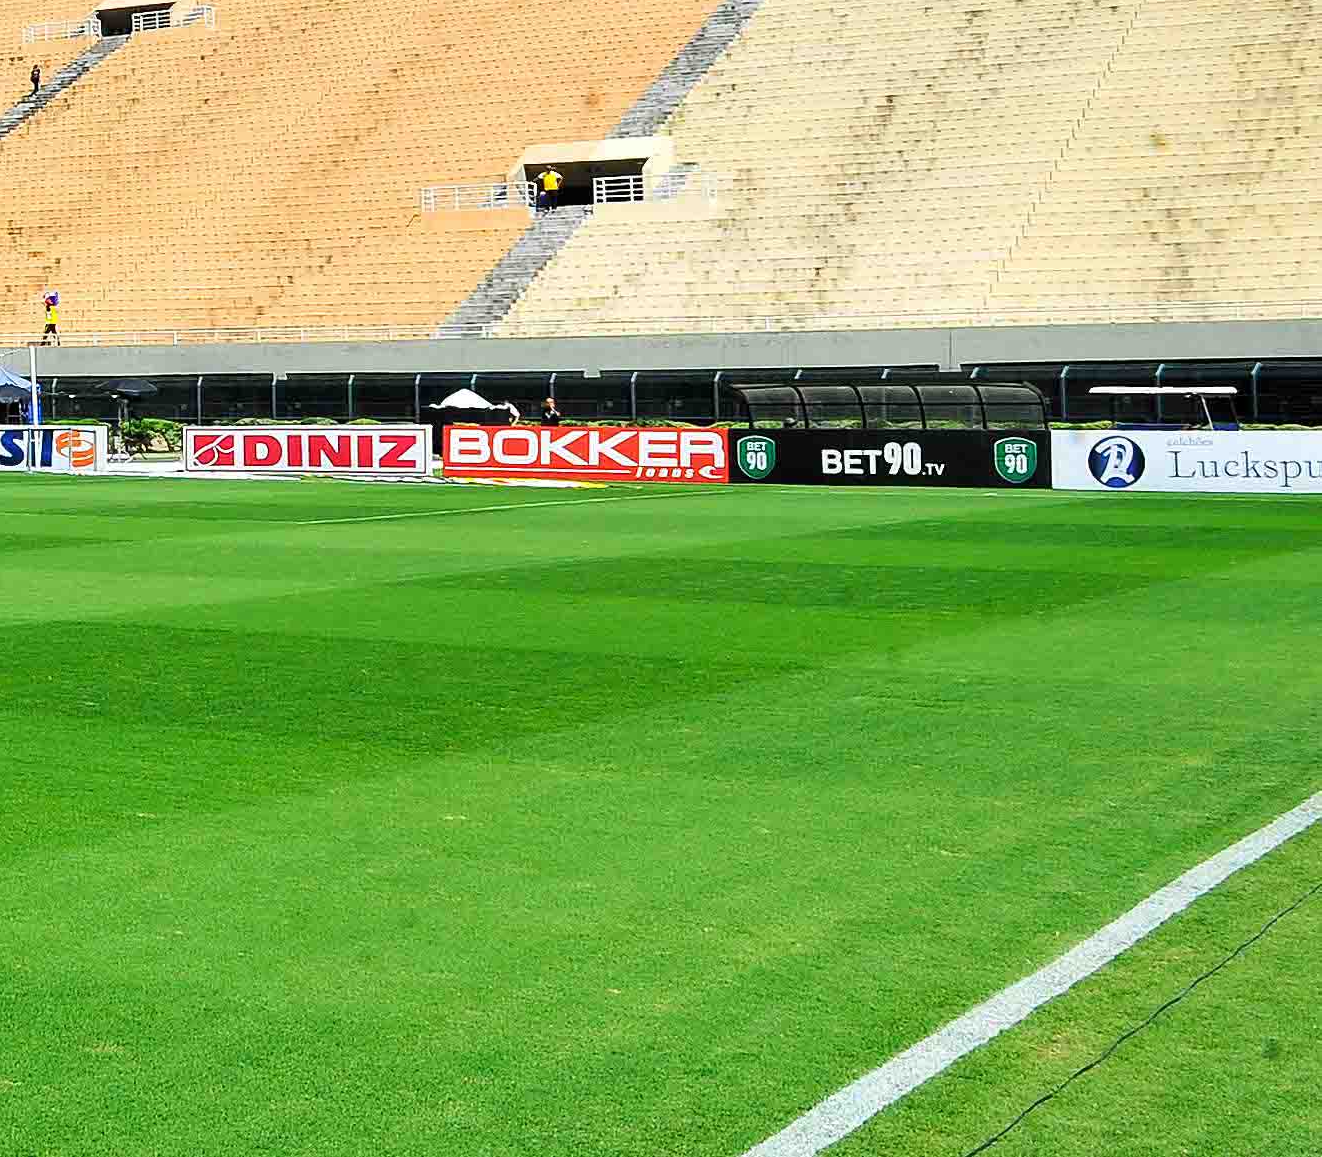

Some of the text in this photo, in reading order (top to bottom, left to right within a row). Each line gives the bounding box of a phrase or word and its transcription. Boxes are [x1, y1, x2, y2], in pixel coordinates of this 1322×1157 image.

[243, 434, 417, 469] DINIZ
[448, 429, 726, 469] BOKKER
[745, 441, 768, 452] BET
[1004, 444, 1028, 454] BET
[745, 451, 768, 471] 90
[1004, 454, 1028, 475] 90
